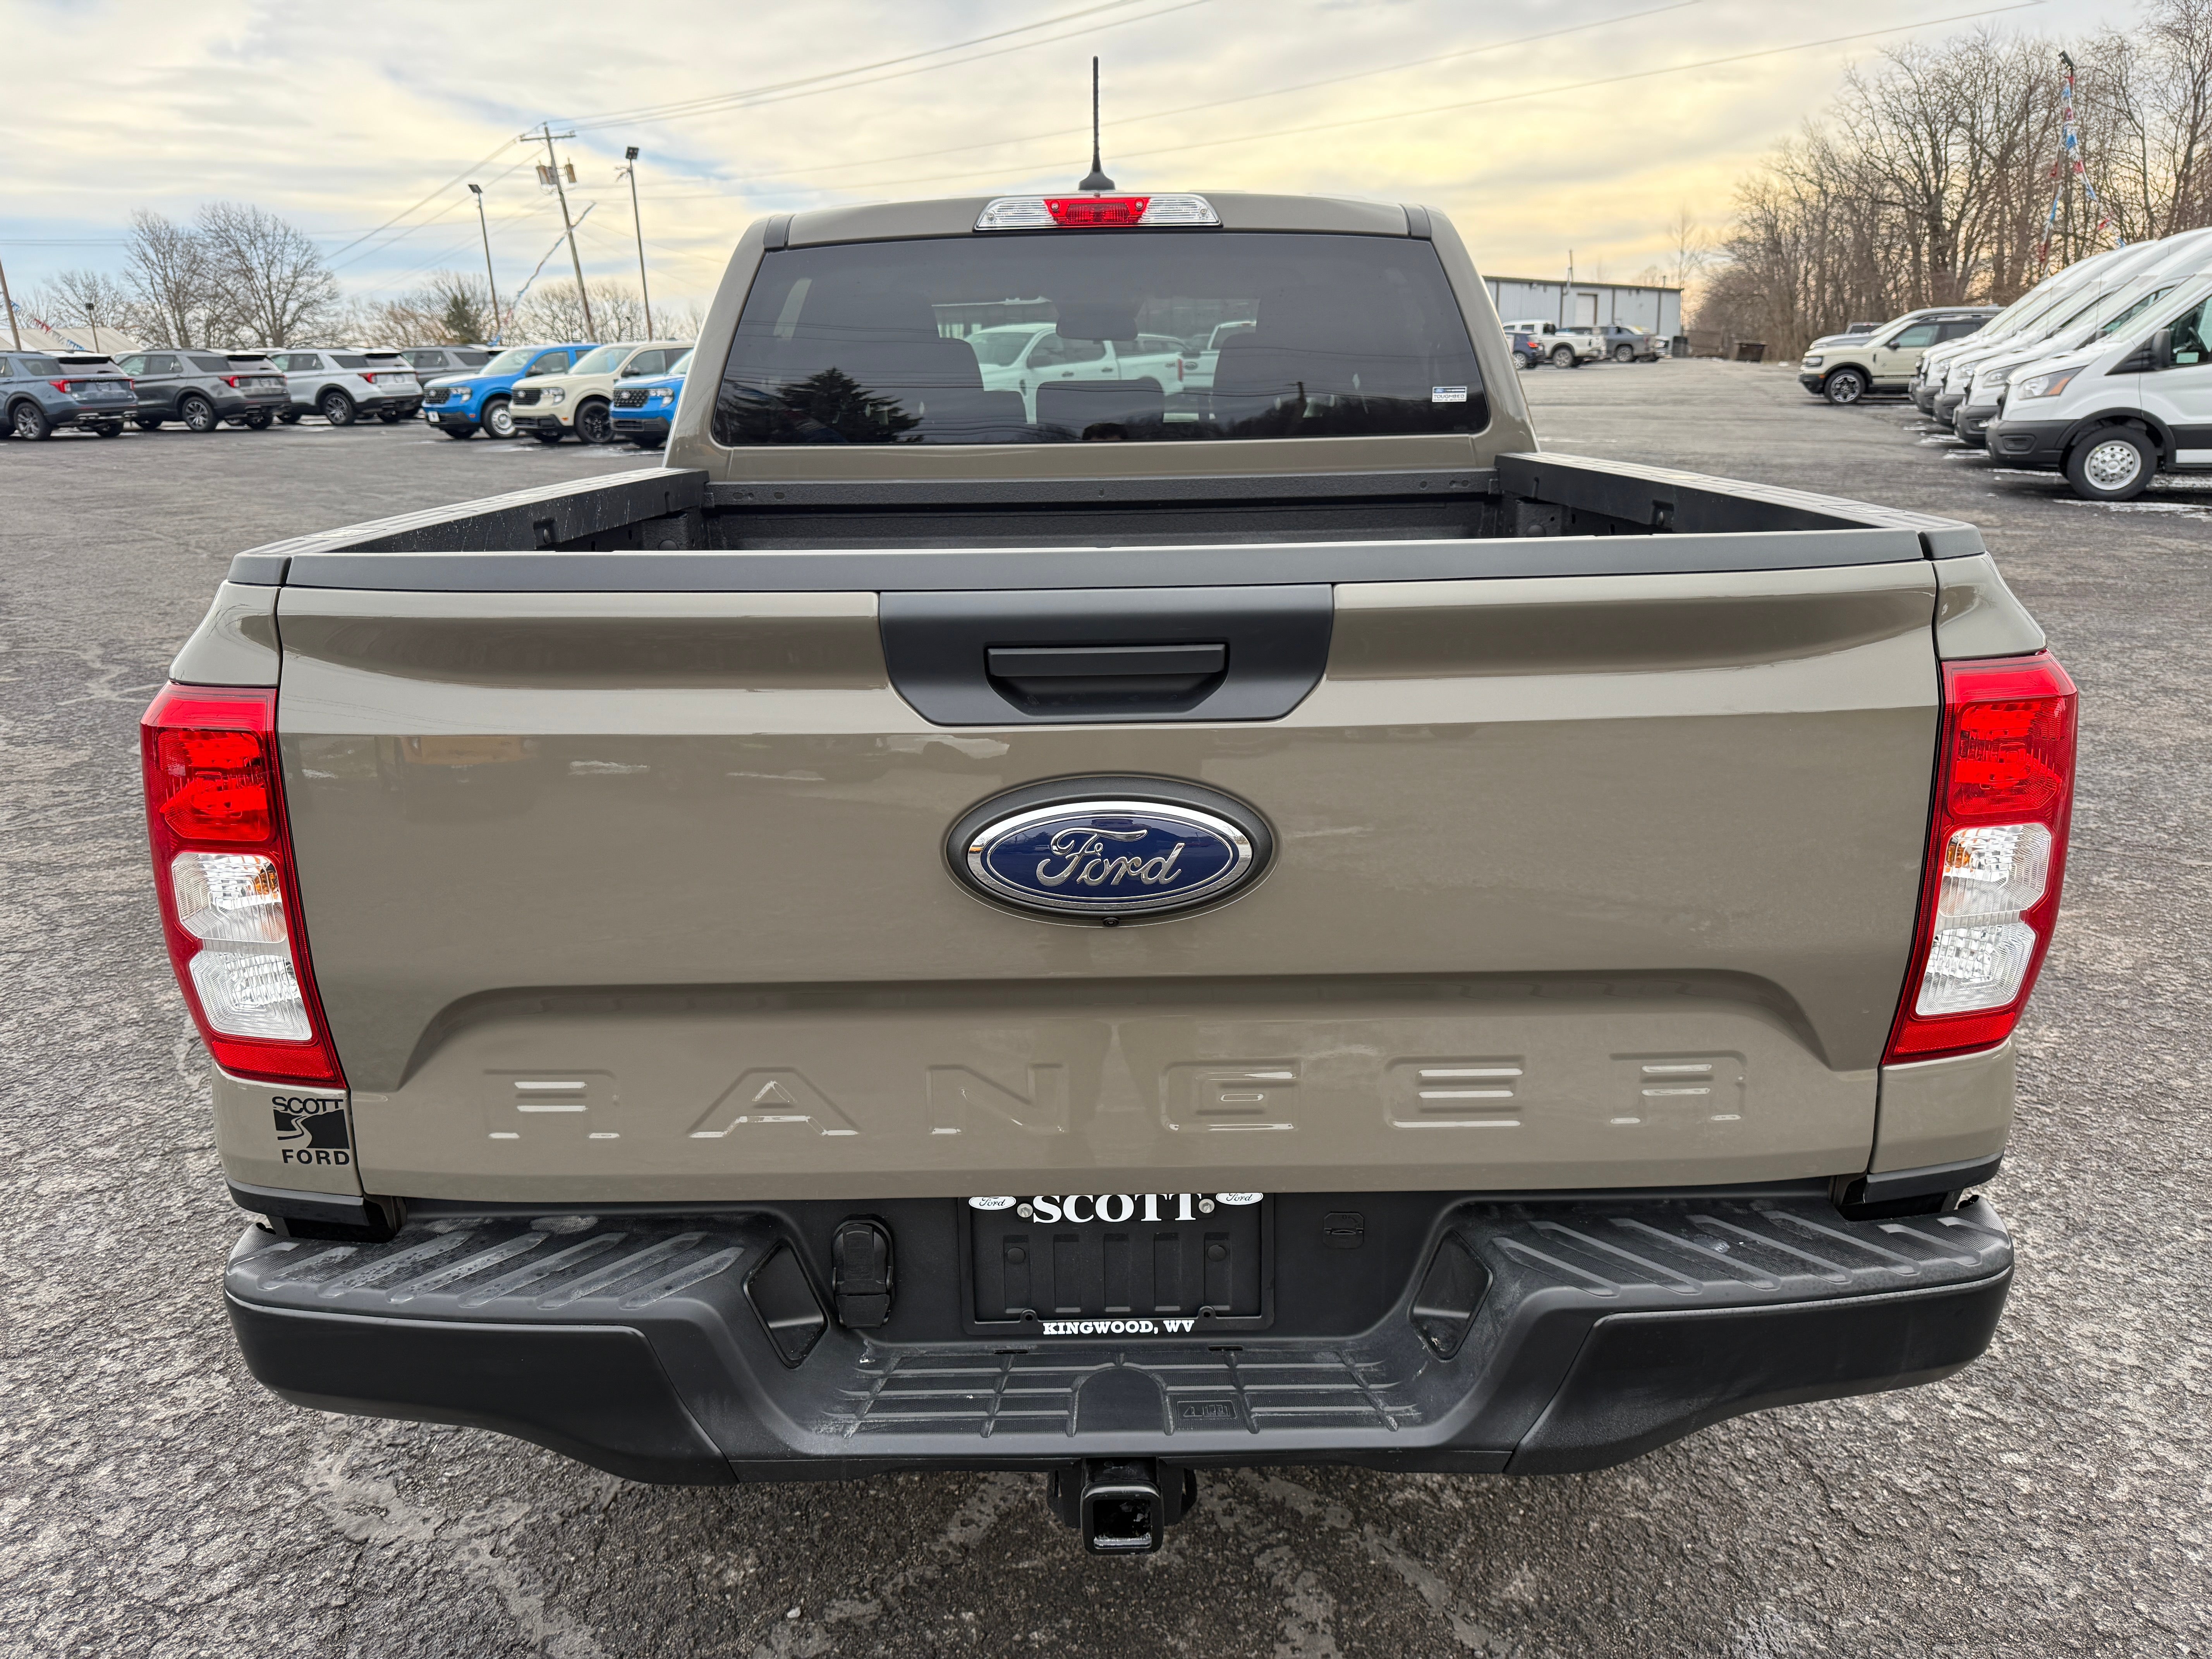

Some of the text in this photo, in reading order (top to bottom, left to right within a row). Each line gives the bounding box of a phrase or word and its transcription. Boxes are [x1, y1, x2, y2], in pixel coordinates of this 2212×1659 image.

[1036, 827, 1185, 886] Ford
[483, 1050, 1747, 1139] RANGER
[272, 1096, 343, 1114] SCOTT
[282, 1149, 350, 1165] FORD
[979, 1197, 1006, 1206] Ford
[1033, 1194, 1202, 1223] SCOTT
[1043, 1320, 1195, 1334] KINGWOOD, WV
